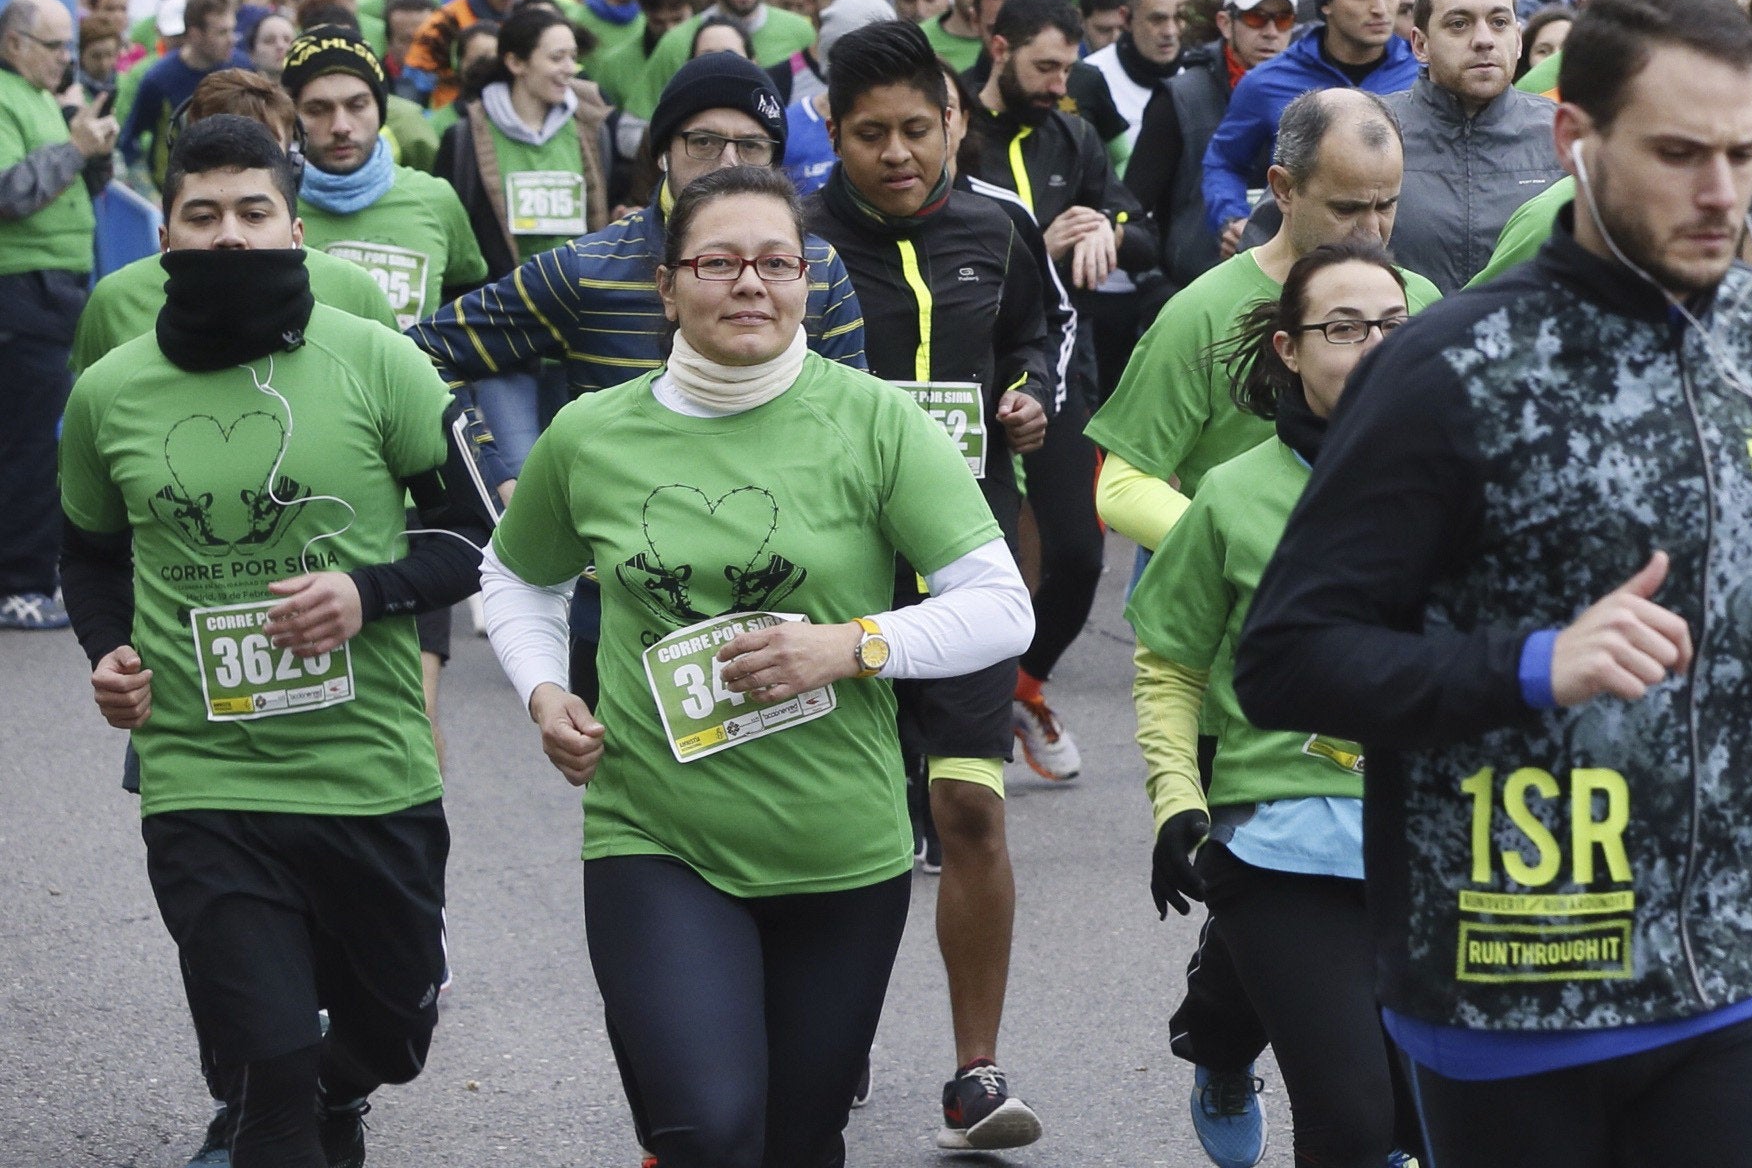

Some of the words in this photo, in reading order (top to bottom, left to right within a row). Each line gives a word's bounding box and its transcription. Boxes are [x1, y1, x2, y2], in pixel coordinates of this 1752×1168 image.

[919, 391, 942, 403] POR
[944, 391, 974, 404] SIRIA
[160, 563, 225, 582] CORRE
[231, 559, 278, 578] POR
[284, 550, 340, 573] SIRIA
[206, 612, 254, 632] CORRE
[657, 633, 712, 664] CORRE
[712, 622, 746, 646] POR
[746, 615, 783, 632] SIRI
[674, 656, 746, 721] 34
[1460, 766, 1634, 887] 1SR
[1468, 939, 1508, 965] RUN
[1510, 938, 1600, 966] THROUGH
[1602, 936, 1621, 961] IT
